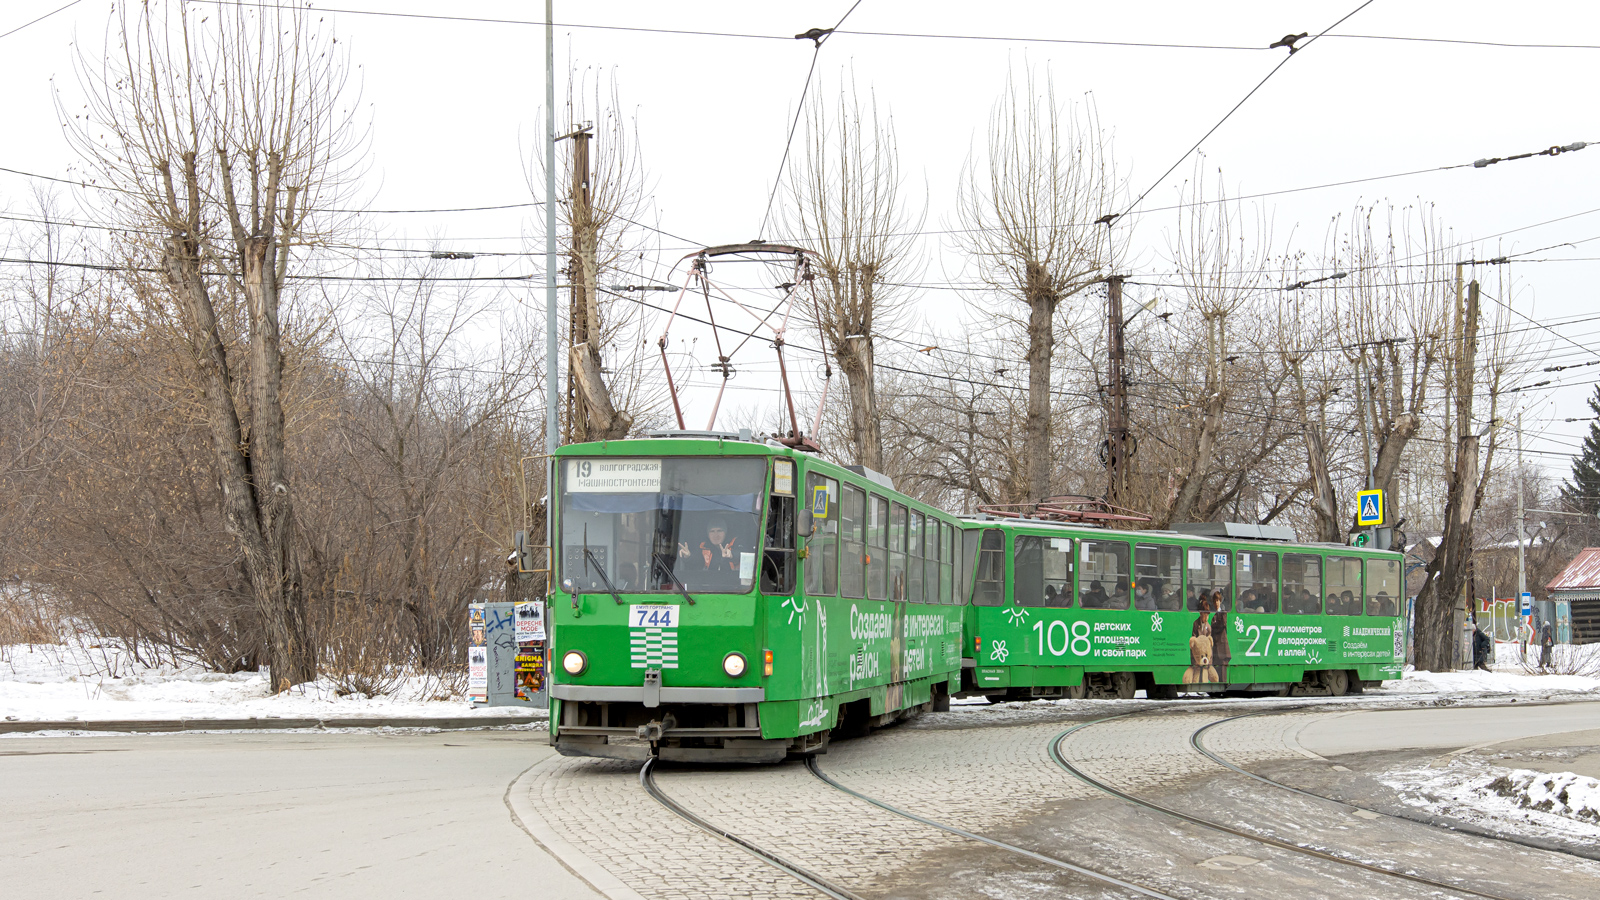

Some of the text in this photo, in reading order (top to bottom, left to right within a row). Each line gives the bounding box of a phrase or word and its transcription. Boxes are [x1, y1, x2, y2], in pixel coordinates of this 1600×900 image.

[576, 461, 591, 477] 19
[1214, 554, 1226, 565] 745
[637, 610, 671, 626] 744
[850, 603, 891, 645] Создаём
[903, 614, 909, 638] в
[909, 614, 944, 644] интересах
[1093, 622, 1132, 632] детских
[1278, 626, 1323, 635] километров
[1352, 625, 1391, 637] АКАДЕМИЧЕСКИЙ
[1033, 620, 1091, 657] 108
[1093, 636, 1140, 646] площадок
[1245, 625, 1276, 657] 27
[1278, 637, 1327, 646] велодорожек
[1343, 641, 1368, 650] Создаём
[1094, 649, 1100, 657] и
[1101, 647, 1124, 657] свой
[1125, 649, 1147, 659] парк
[1278, 647, 1306, 657] и аллей
[1376, 649, 1391, 658] детей
[903, 640, 924, 678] детей
[849, 643, 878, 691] район
